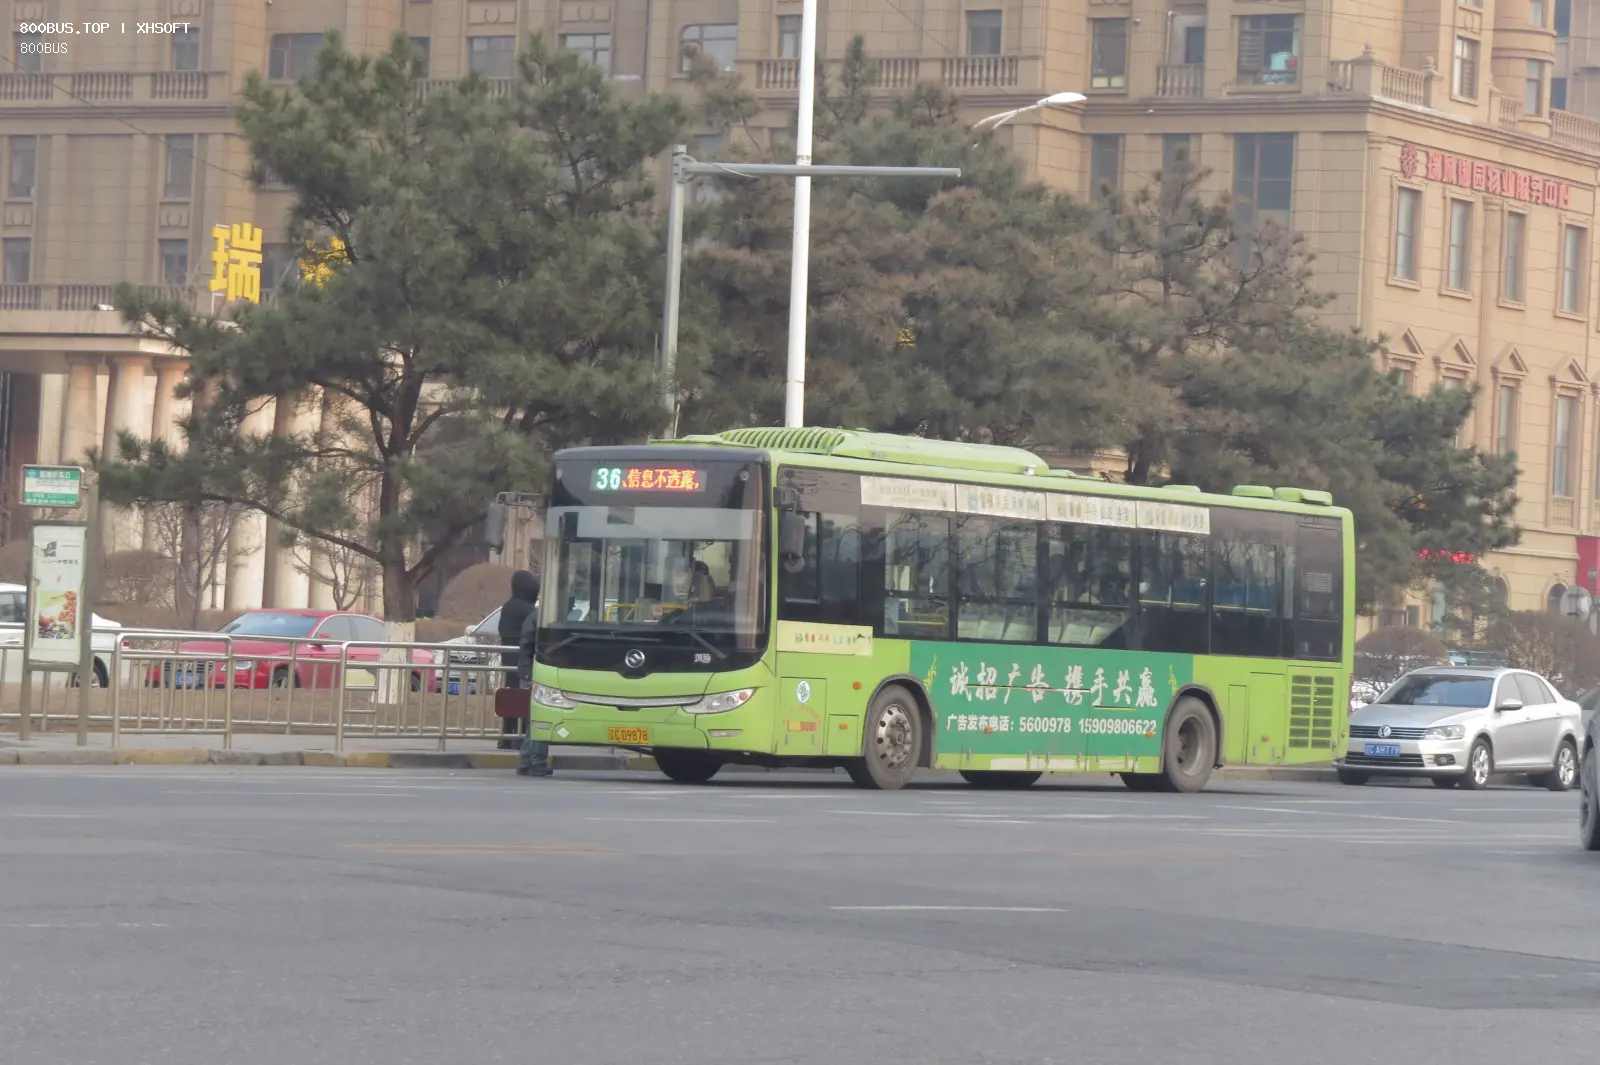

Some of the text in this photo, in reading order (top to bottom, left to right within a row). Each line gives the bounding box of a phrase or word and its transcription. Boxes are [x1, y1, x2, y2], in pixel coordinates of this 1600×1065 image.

[596, 467, 622, 490] 36
[949, 661, 1158, 708] 诚招广告 携手共赢
[621, 729, 648, 741] D9878
[1019, 716, 1072, 734] 5600978
[1078, 718, 1157, 736] 15909806622
